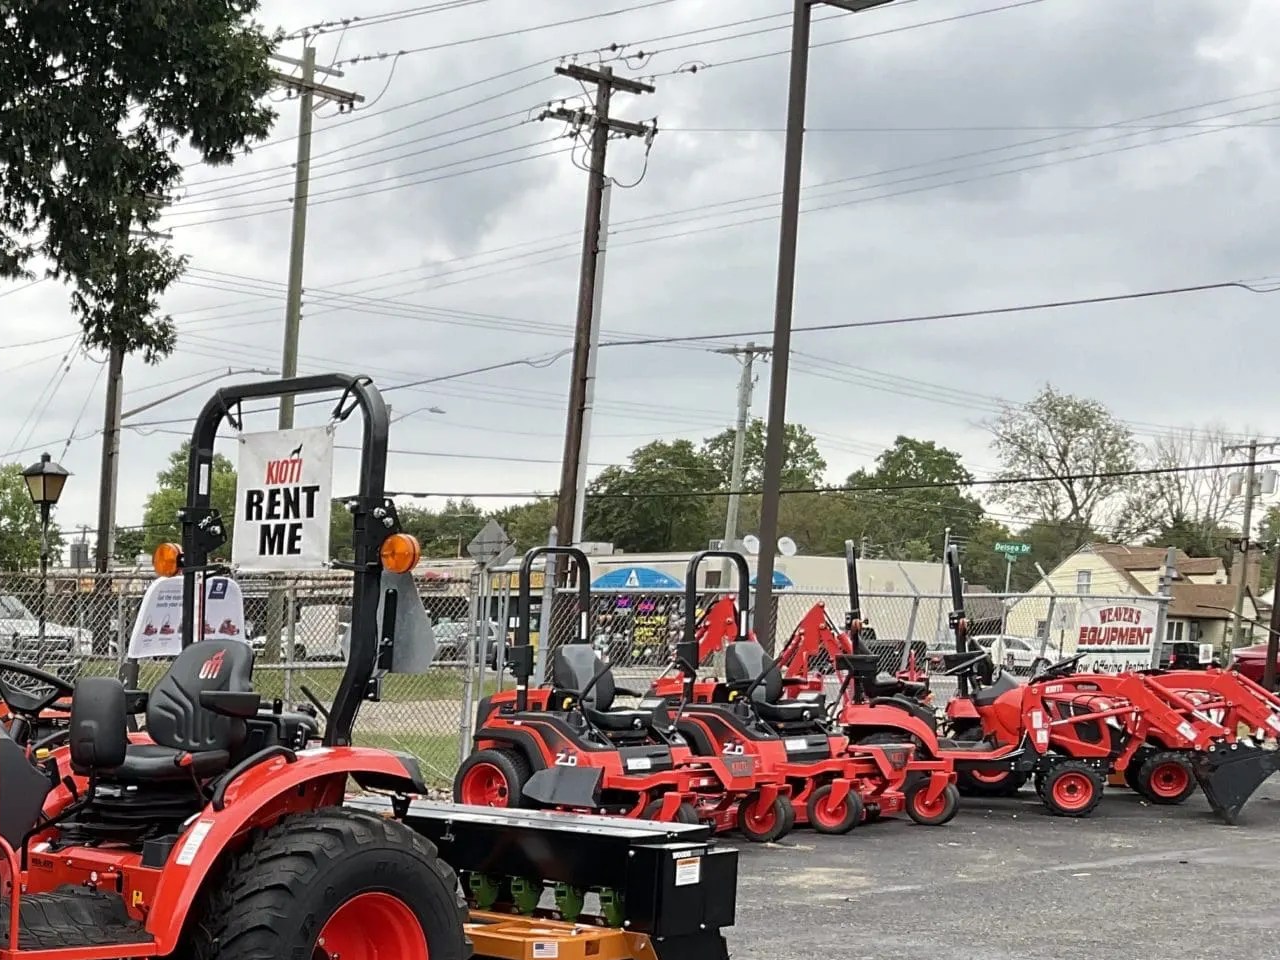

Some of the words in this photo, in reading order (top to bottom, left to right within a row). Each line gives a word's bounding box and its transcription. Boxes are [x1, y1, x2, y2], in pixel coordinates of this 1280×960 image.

[266, 459, 302, 484] KIOTI
[245, 486, 320, 521] RENT
[259, 523, 303, 556] ME
[995, 543, 1019, 552] Delsea
[1022, 544, 1030, 552] Dr
[1100, 607, 1141, 624] WEAVER'S
[1079, 627, 1153, 645] EQUIPMENT
